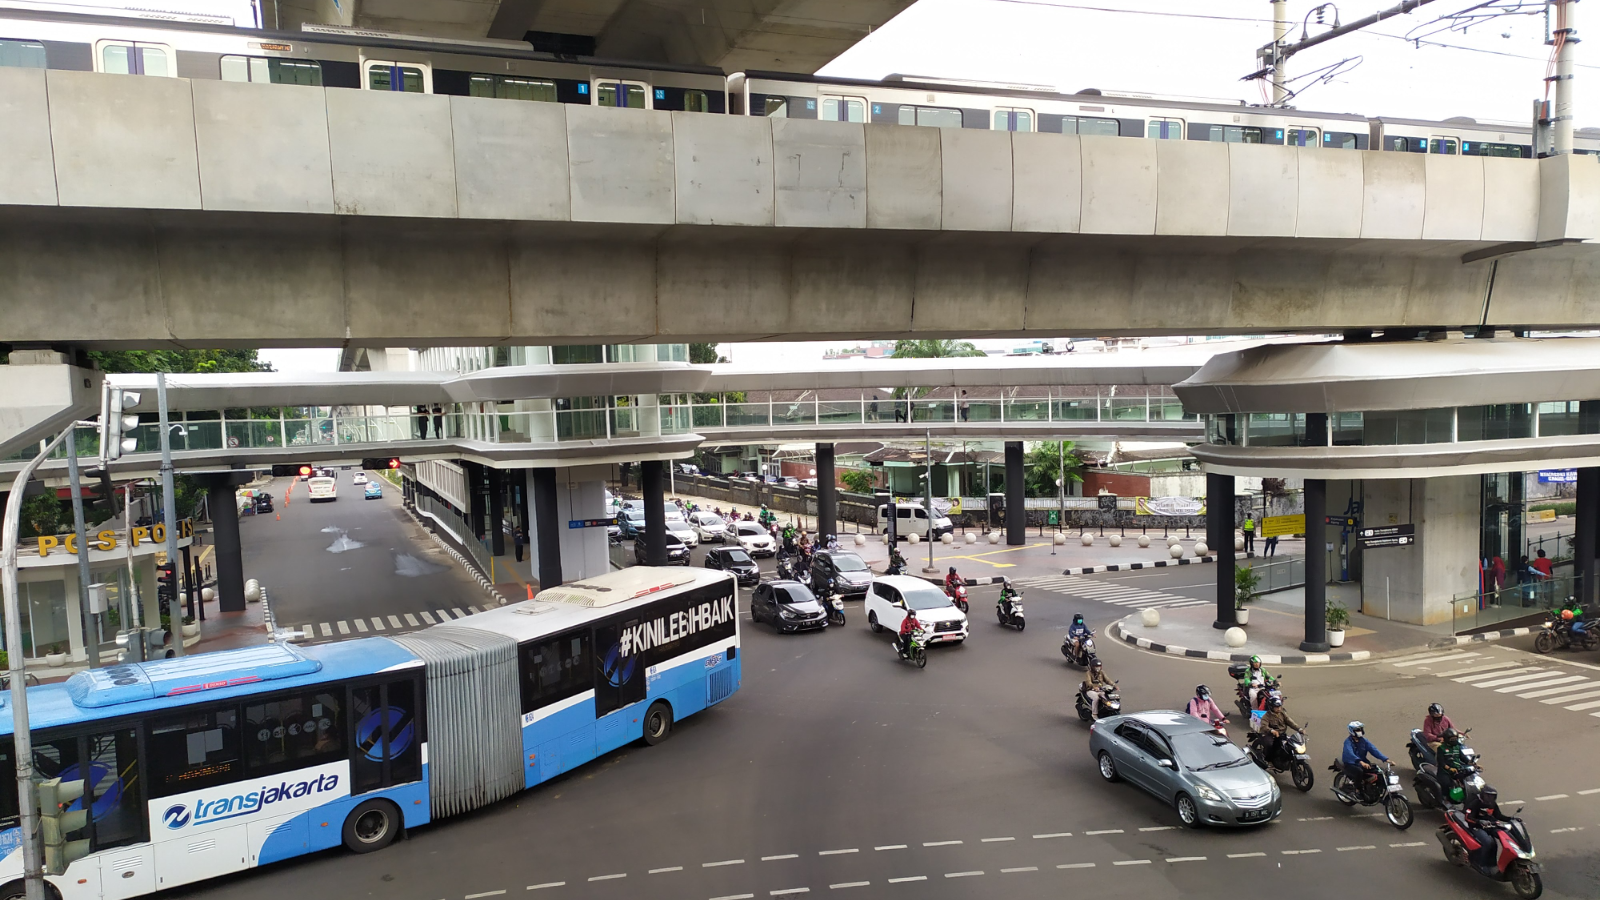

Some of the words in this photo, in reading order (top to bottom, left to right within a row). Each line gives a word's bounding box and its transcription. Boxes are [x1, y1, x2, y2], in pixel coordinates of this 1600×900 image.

[38, 530, 117, 557] POS
[131, 517, 194, 547] POIS
[619, 594, 734, 658] #KINILEBIHBAIK
[193, 773, 339, 823] transjakarta
